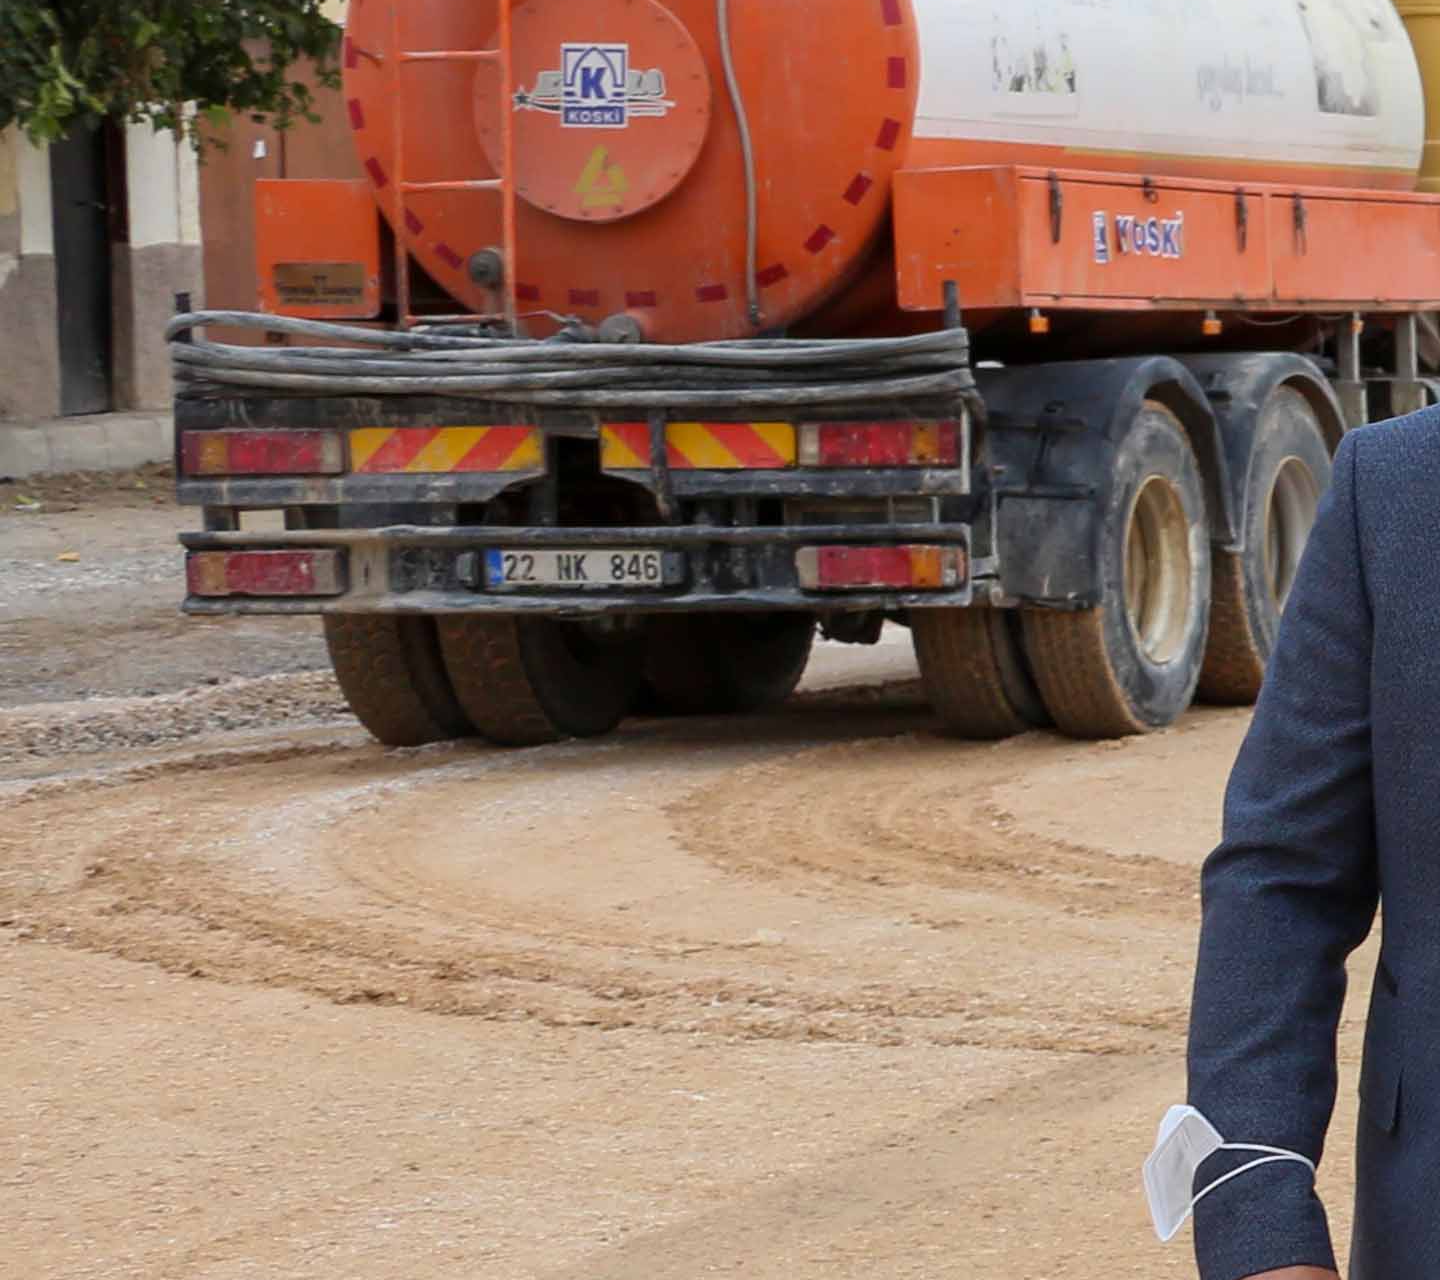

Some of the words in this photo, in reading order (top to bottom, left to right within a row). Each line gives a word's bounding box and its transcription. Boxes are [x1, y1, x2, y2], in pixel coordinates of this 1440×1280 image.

[580, 67, 607, 99] K
[504, 554, 537, 581] 22
[556, 554, 589, 581] NK
[611, 554, 658, 580] 846
